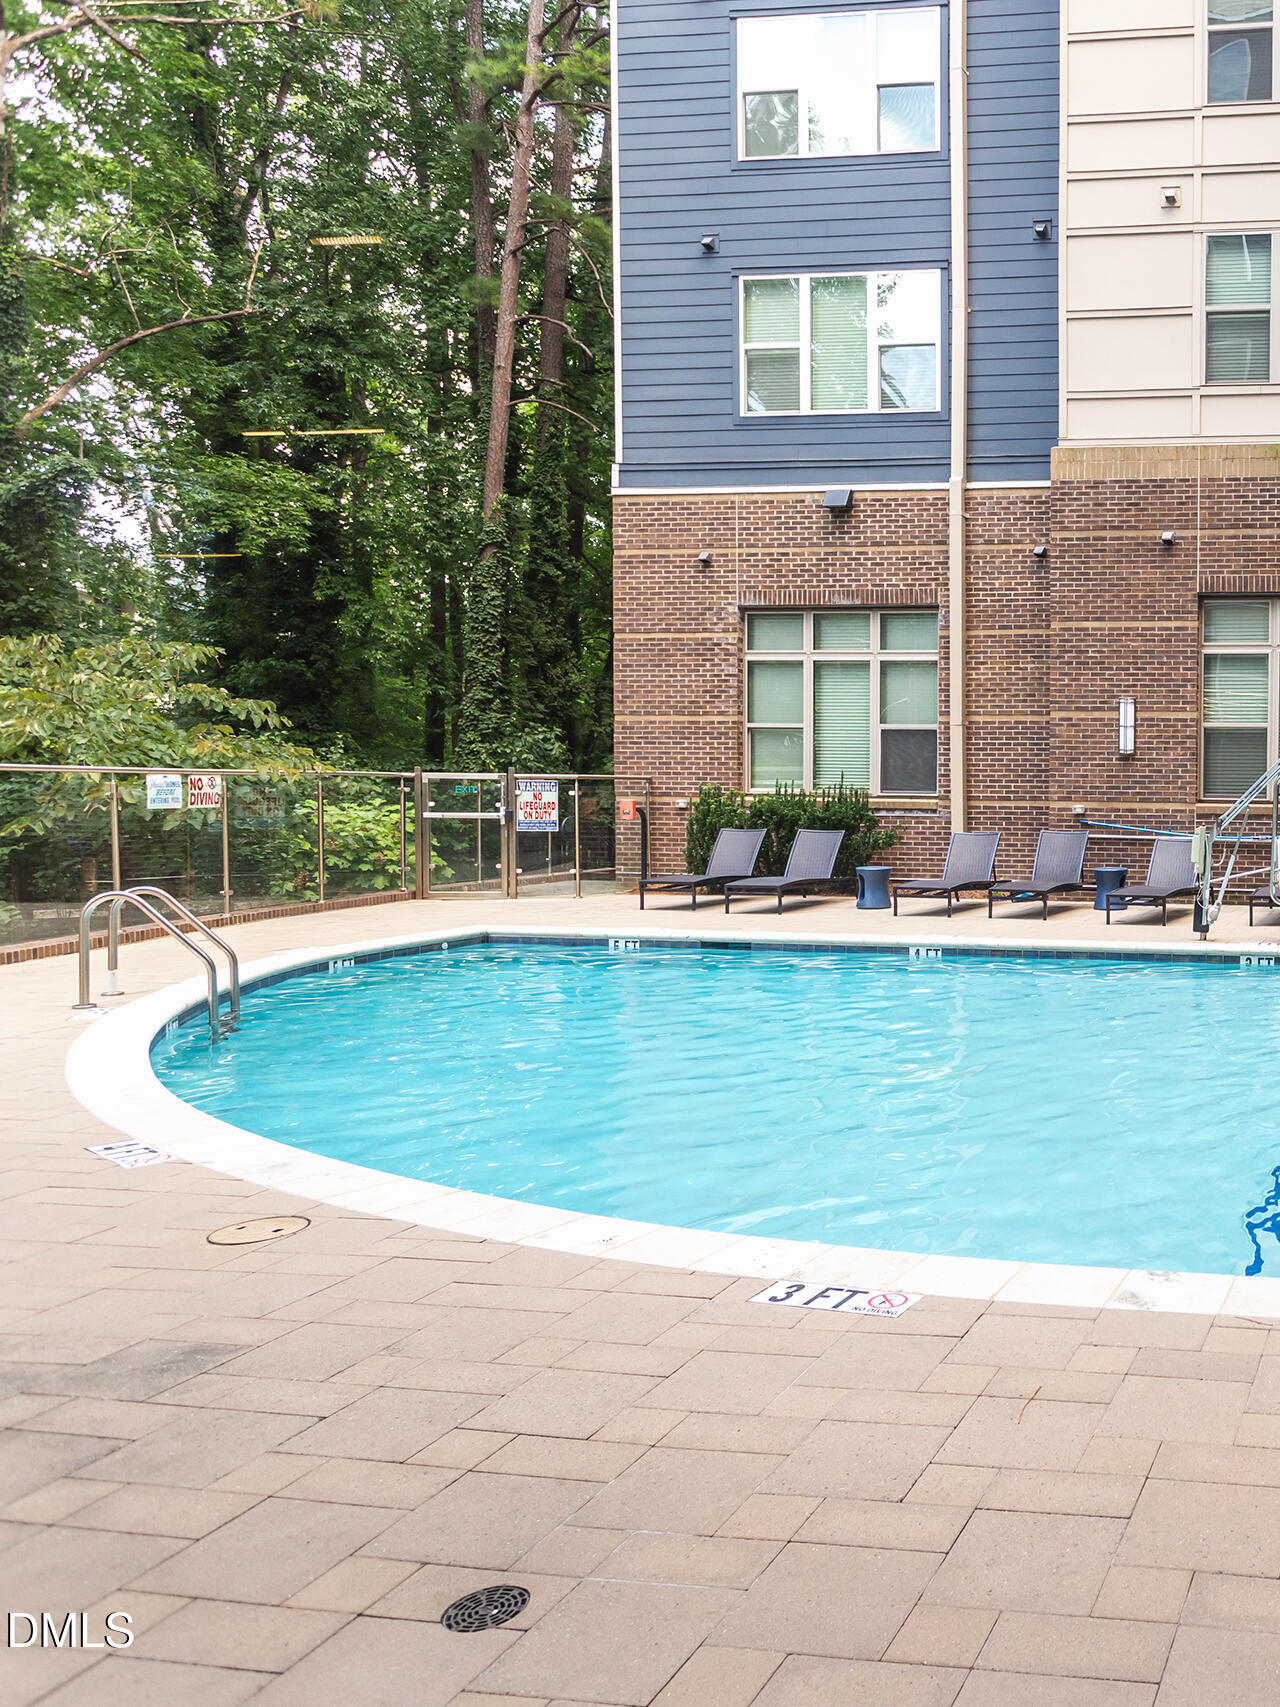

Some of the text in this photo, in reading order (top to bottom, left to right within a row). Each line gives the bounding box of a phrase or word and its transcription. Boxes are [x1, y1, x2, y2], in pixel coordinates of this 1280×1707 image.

[190, 777, 203, 791] NO
[518, 782, 556, 791] WARNING
[455, 785, 477, 793] EXIT
[190, 792, 220, 806] DIVING
[533, 792, 542, 800] NO
[519, 801, 556, 810] LIFEGUARD
[523, 811, 552, 819] ON DUTY
[768, 1284, 869, 1309] 3 FT
[866, 1307, 898, 1316] DIVING
